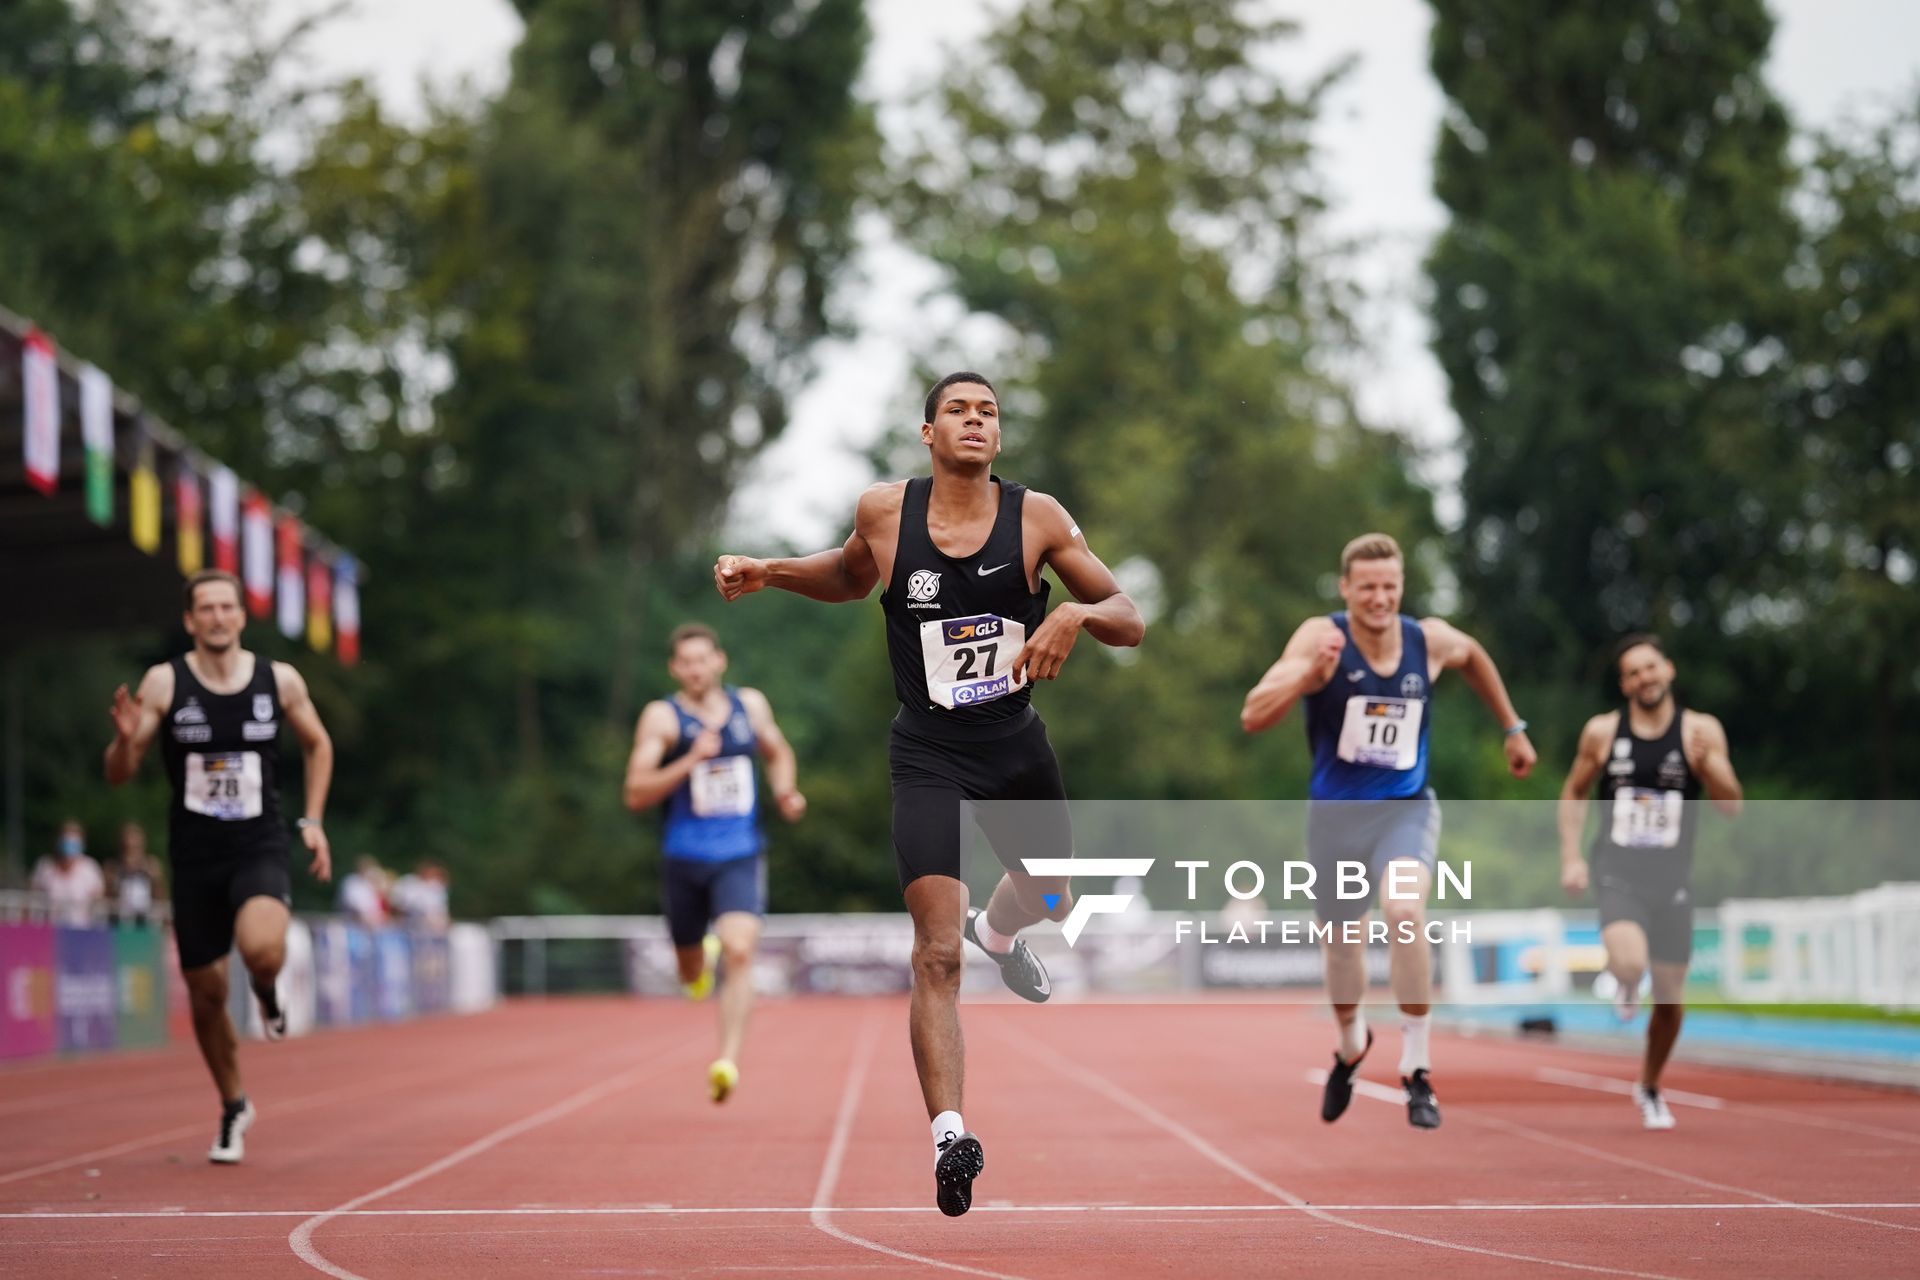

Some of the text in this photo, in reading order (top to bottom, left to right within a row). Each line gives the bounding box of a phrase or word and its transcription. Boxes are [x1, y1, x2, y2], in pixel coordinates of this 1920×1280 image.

[908, 571, 941, 600] 96
[975, 621, 998, 636] GLS
[953, 643, 998, 681] 27
[976, 680, 1007, 695] PLAN
[1368, 722, 1399, 747] 10
[207, 778, 240, 799] 28
